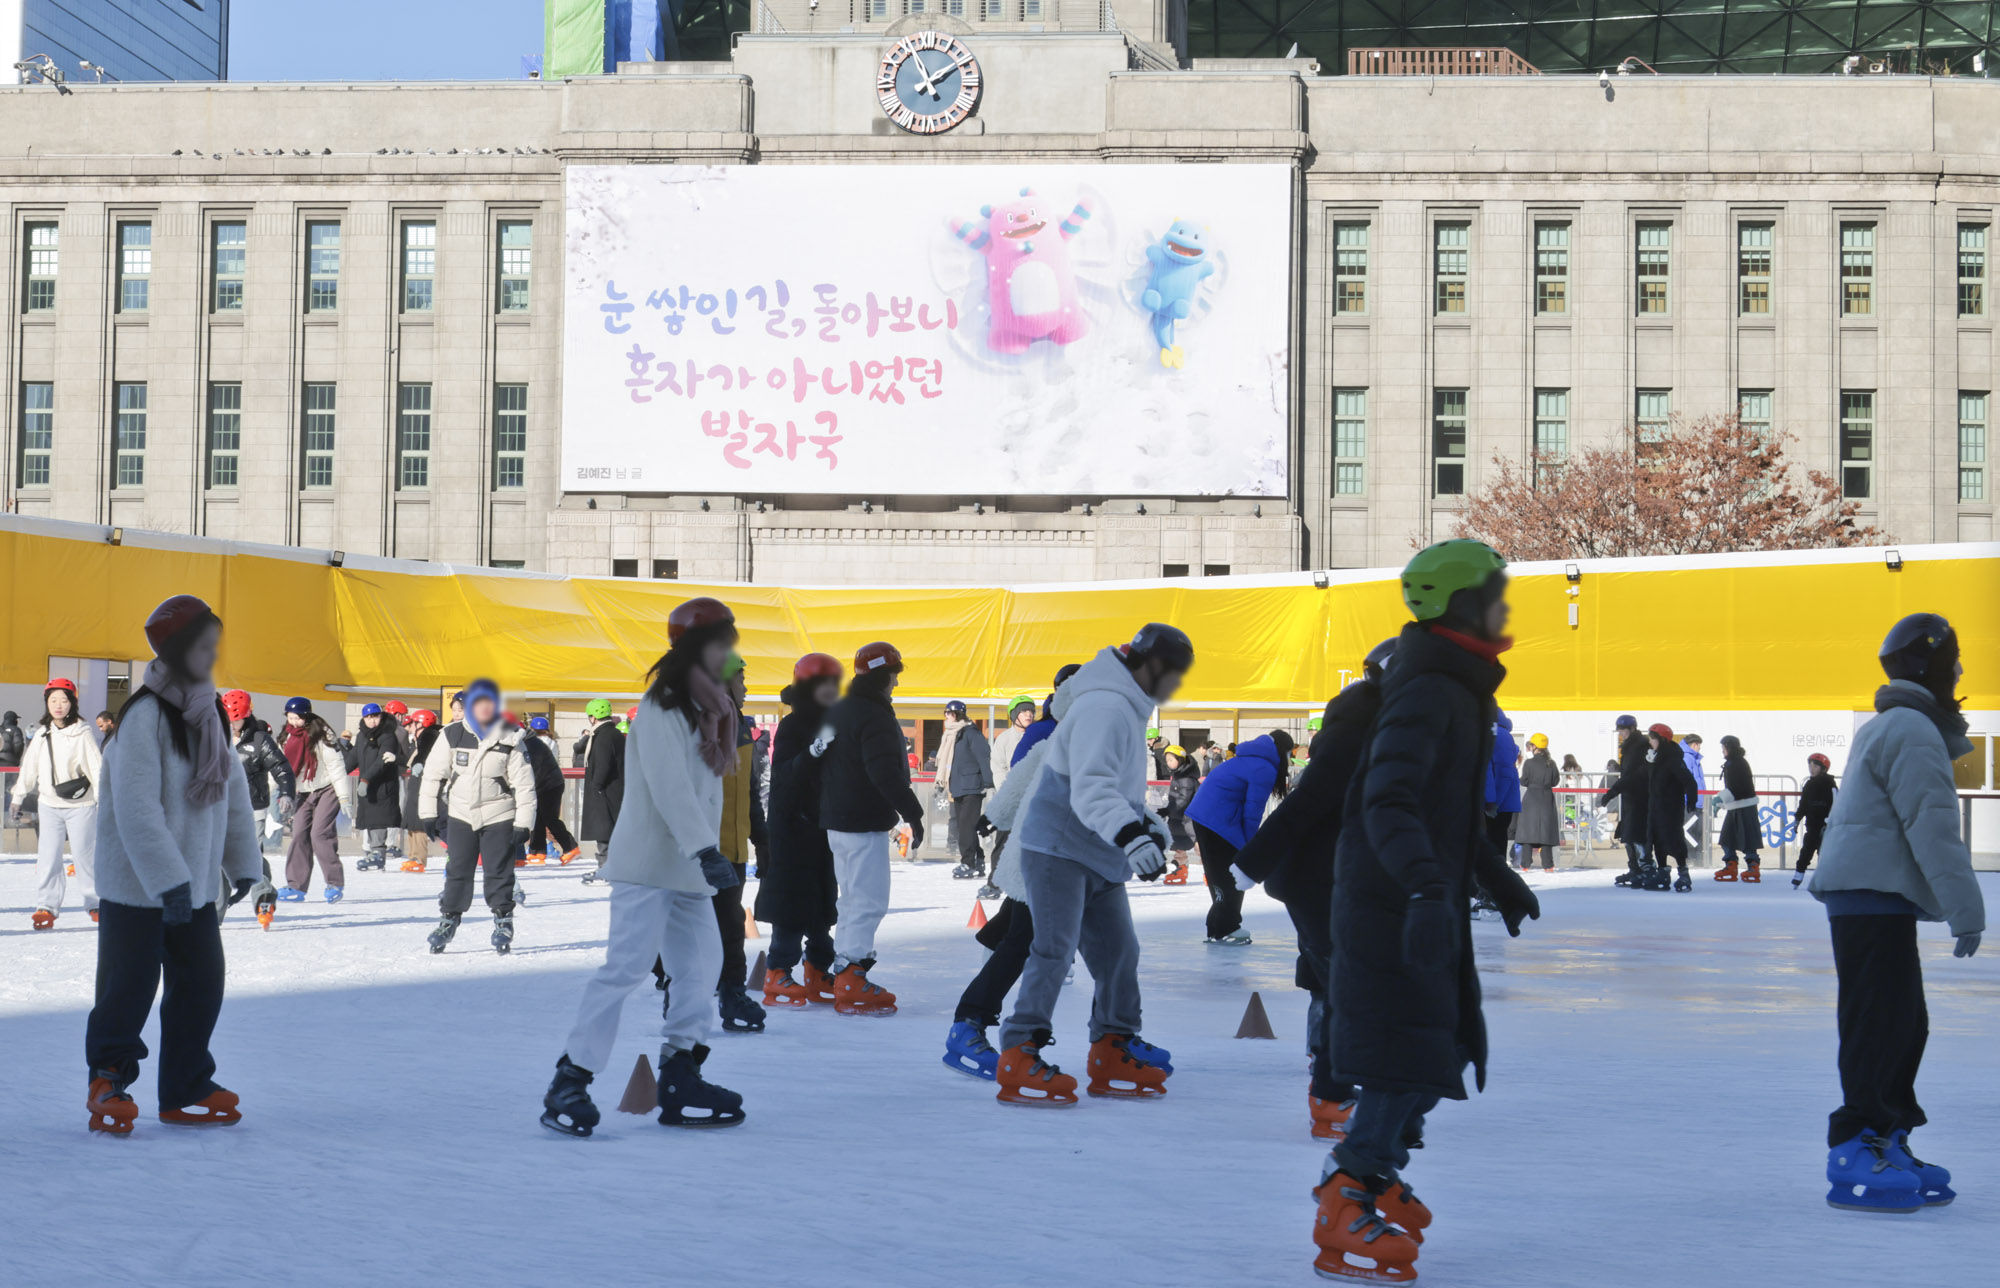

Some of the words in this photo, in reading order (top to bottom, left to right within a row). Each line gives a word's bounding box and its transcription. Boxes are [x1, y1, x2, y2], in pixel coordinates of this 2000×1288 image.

[919, 31, 936, 49] XII
[882, 53, 900, 67] X
[961, 74, 979, 87] III
[599, 279, 635, 335] 눈
[645, 284, 738, 336] 쌓인
[813, 283, 958, 342] 돌아보니
[624, 343, 757, 404] 혼자가
[766, 355, 943, 405] 아니었던
[700, 409, 844, 471] 발자국
[577, 467, 612, 479] 김예진
[615, 467, 627, 479] 님
[631, 467, 643, 479] 글
